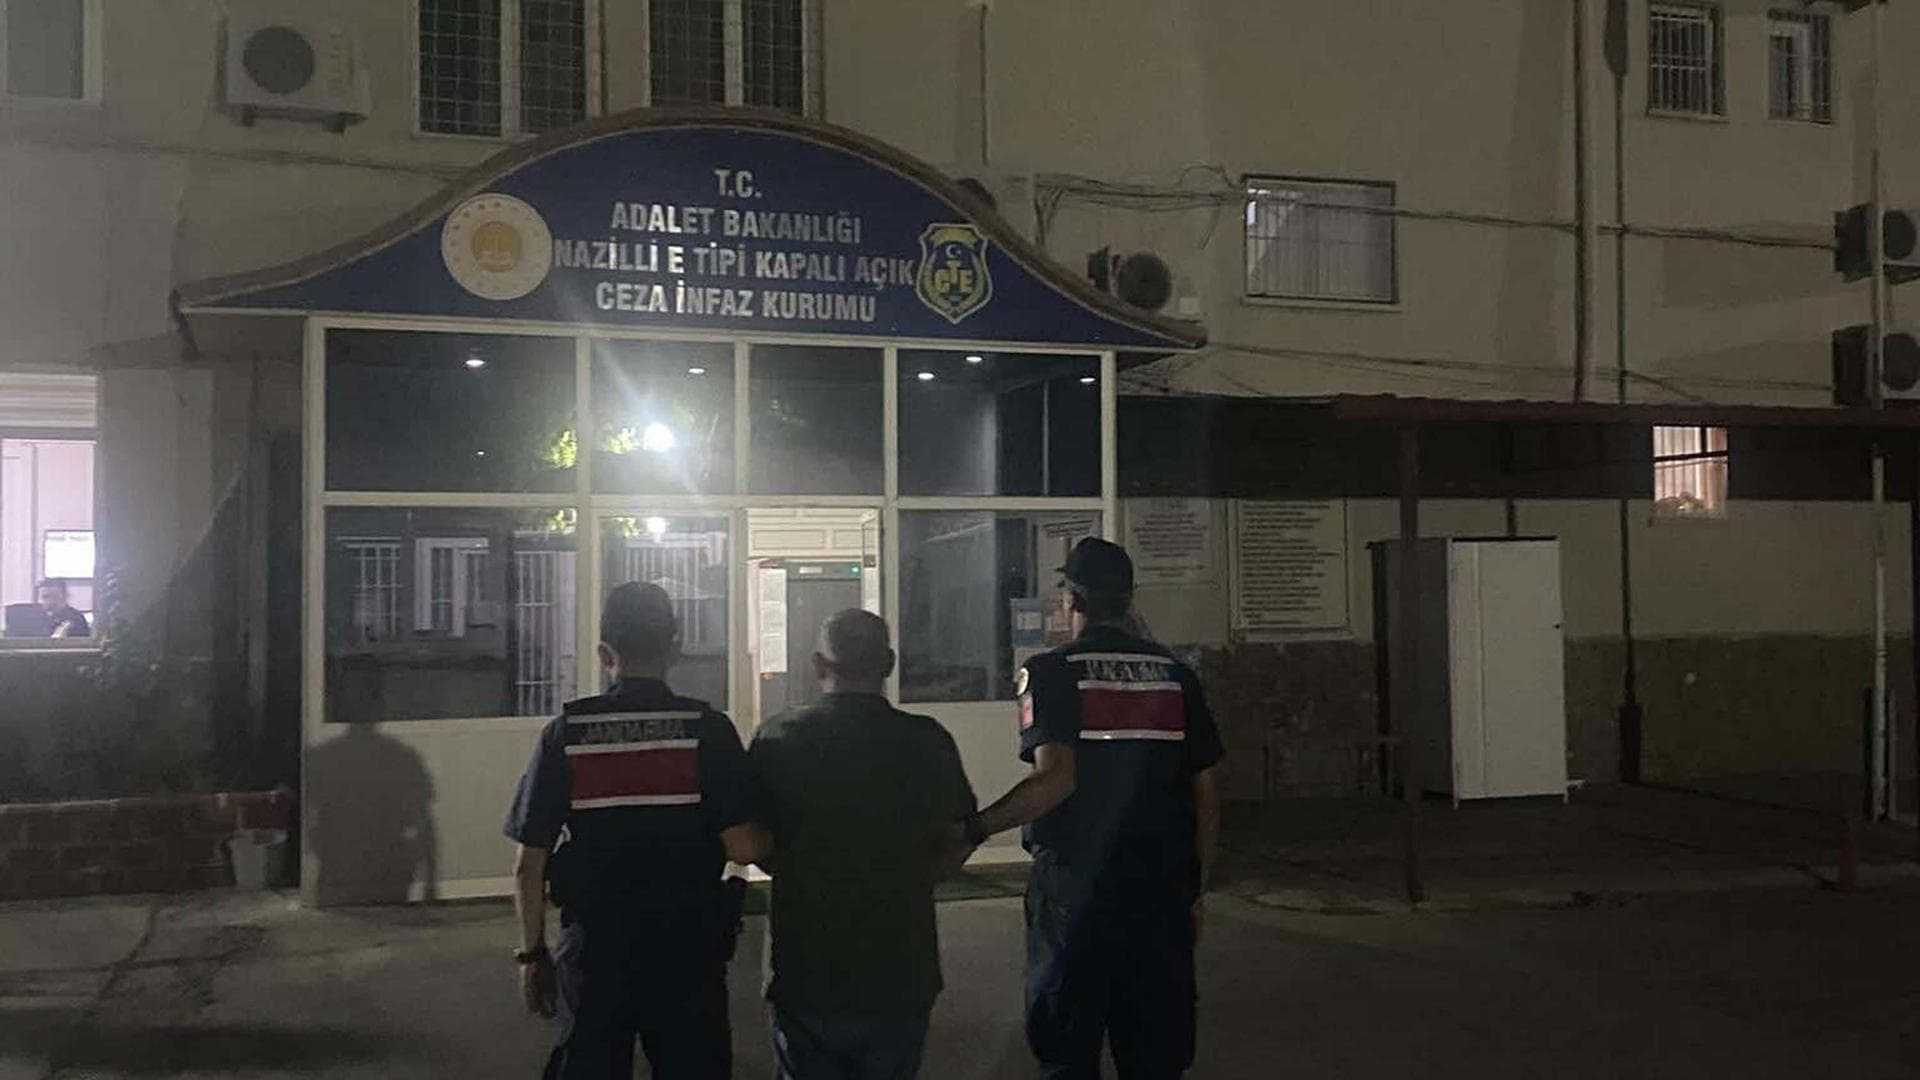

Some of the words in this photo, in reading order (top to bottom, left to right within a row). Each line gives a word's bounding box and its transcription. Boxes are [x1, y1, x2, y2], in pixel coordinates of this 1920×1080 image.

[714, 168, 763, 199] T.C.
[610, 201, 715, 235] ADALET
[723, 208, 861, 244] BAKANLIĞI
[554, 236, 659, 273] NAZİLLİ
[667, 245, 685, 274] E
[692, 241, 747, 277] TİPİ
[755, 250, 846, 282] KAPALI
[854, 256, 915, 291] AÇIK
[595, 281, 669, 313] CEZA
[675, 279, 754, 316] İNFAZ
[762, 289, 876, 323] KURUMU
